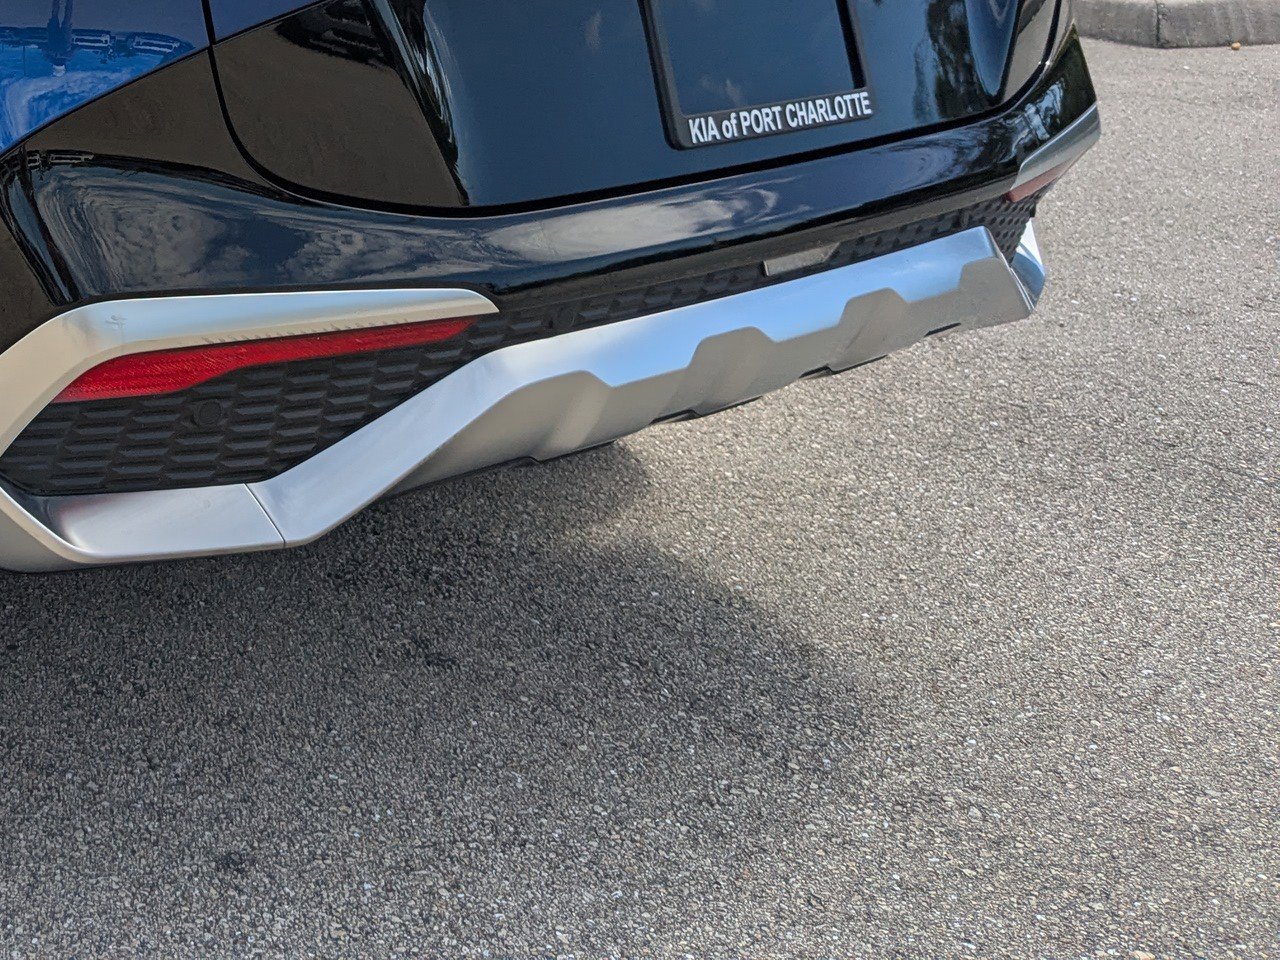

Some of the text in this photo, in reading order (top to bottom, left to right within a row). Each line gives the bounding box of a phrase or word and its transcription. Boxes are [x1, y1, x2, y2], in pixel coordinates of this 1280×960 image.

[688, 92, 872, 144] KIA of PORT CHARLOTTE
